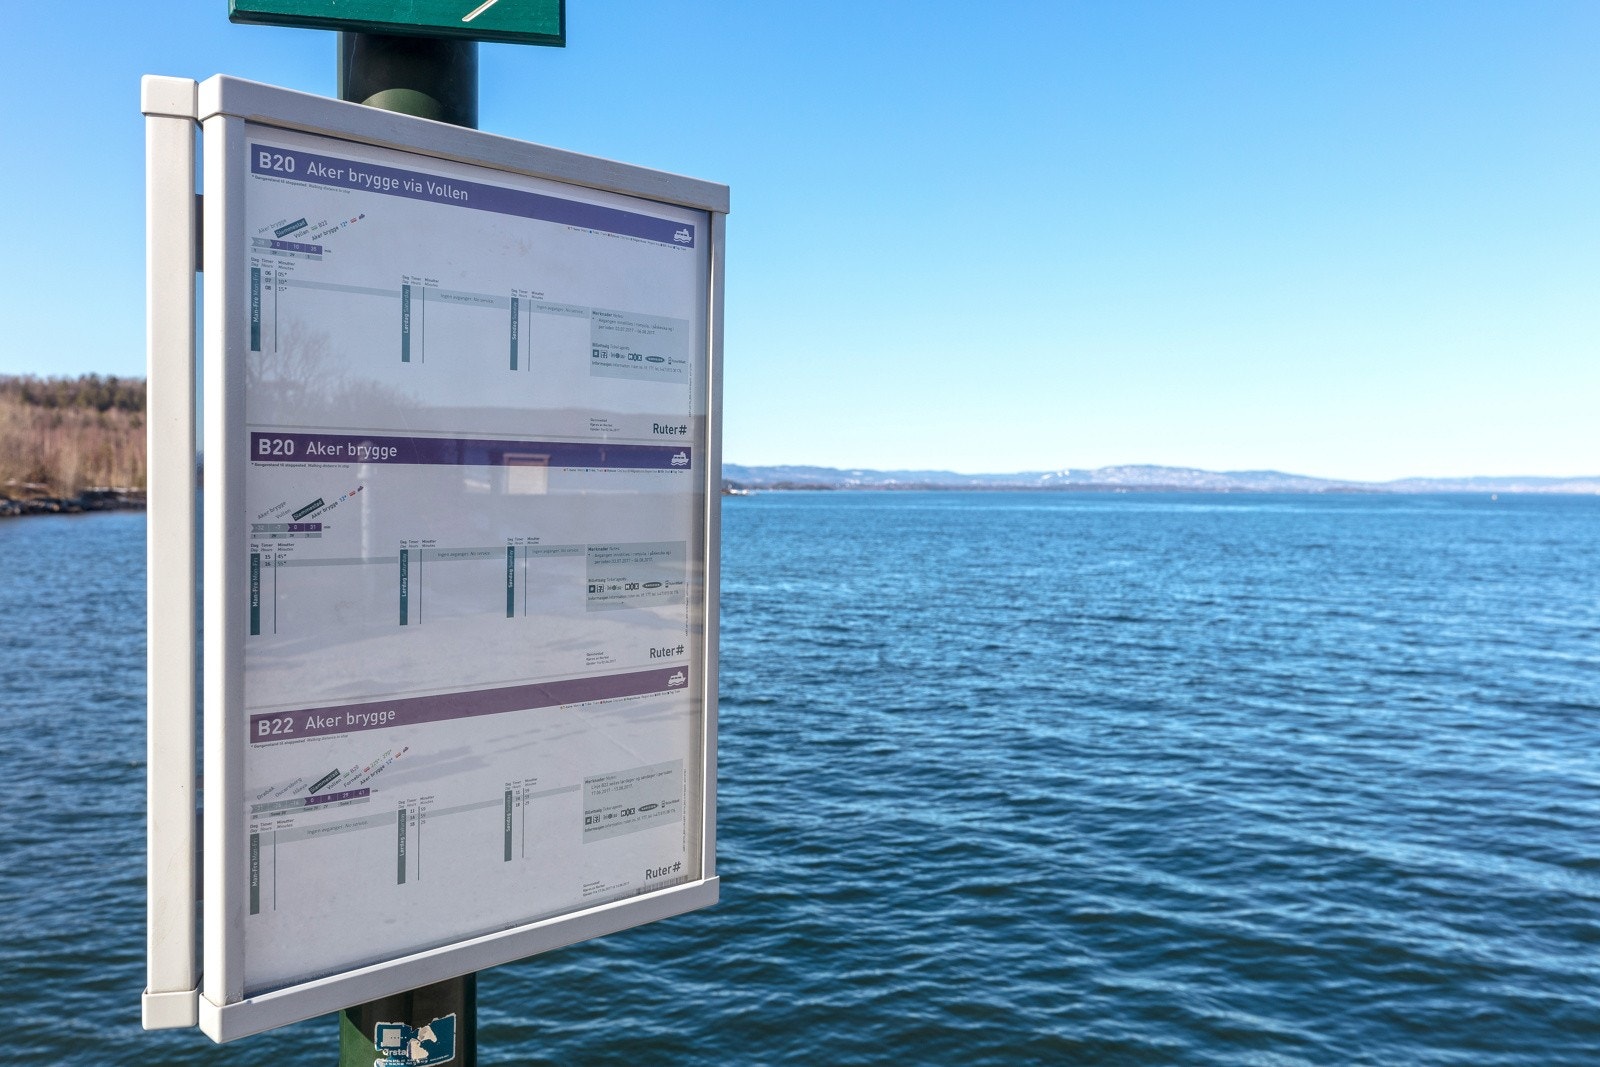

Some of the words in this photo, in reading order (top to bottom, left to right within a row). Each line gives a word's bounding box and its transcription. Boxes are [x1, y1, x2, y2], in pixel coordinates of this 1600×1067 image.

[259, 151, 295, 173] B20
[306, 161, 345, 180] Aker
[349, 167, 399, 191] brygge
[403, 178, 422, 193] via
[426, 181, 468, 201] Vollen
[258, 438, 294, 455] B20
[306, 441, 343, 456] Aker
[347, 442, 397, 460] brygge
[258, 717, 294, 736] B22
[305, 715, 342, 730] Aker
[346, 710, 396, 726] brygge
[645, 861, 681, 880] Ruter#
